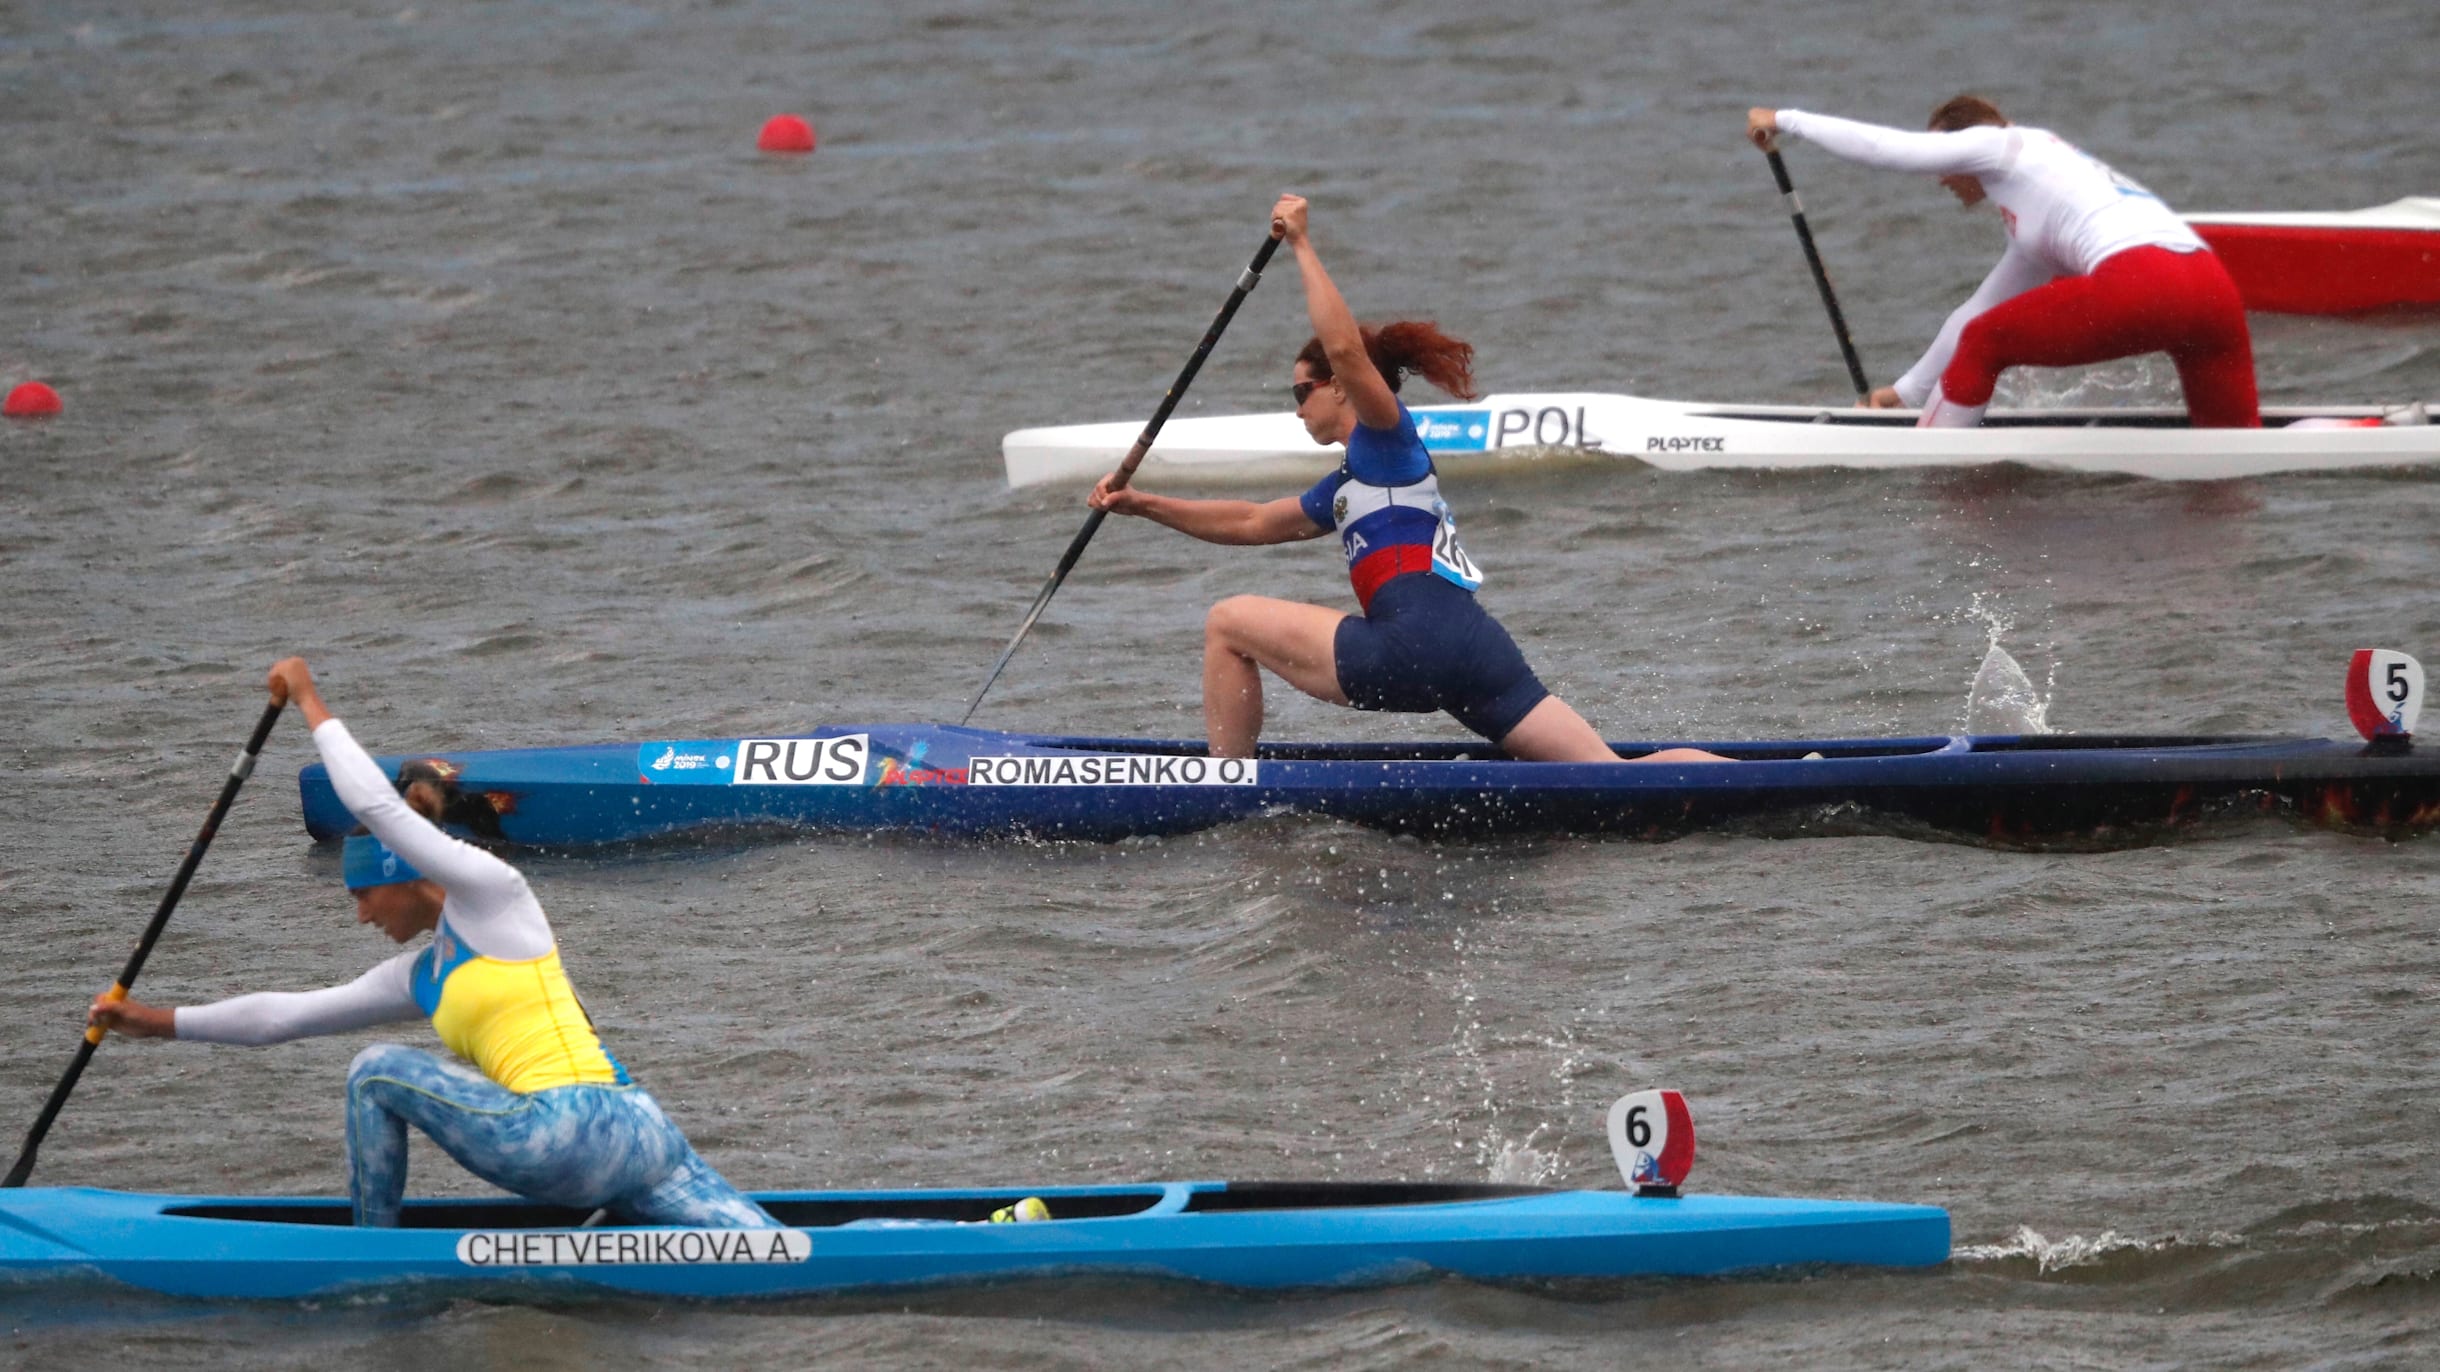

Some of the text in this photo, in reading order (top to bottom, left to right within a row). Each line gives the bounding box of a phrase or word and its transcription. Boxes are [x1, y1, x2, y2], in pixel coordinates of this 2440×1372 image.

[1496, 406, 1602, 447] POL
[2386, 663, 2409, 702] 5
[673, 761, 697, 769] 2019
[743, 738, 863, 781] RUS
[969, 758, 1254, 784] ROMASENKO O.
[1625, 1105, 1652, 1148] 6
[468, 1232, 801, 1264] CHETVERIKOVA A.
